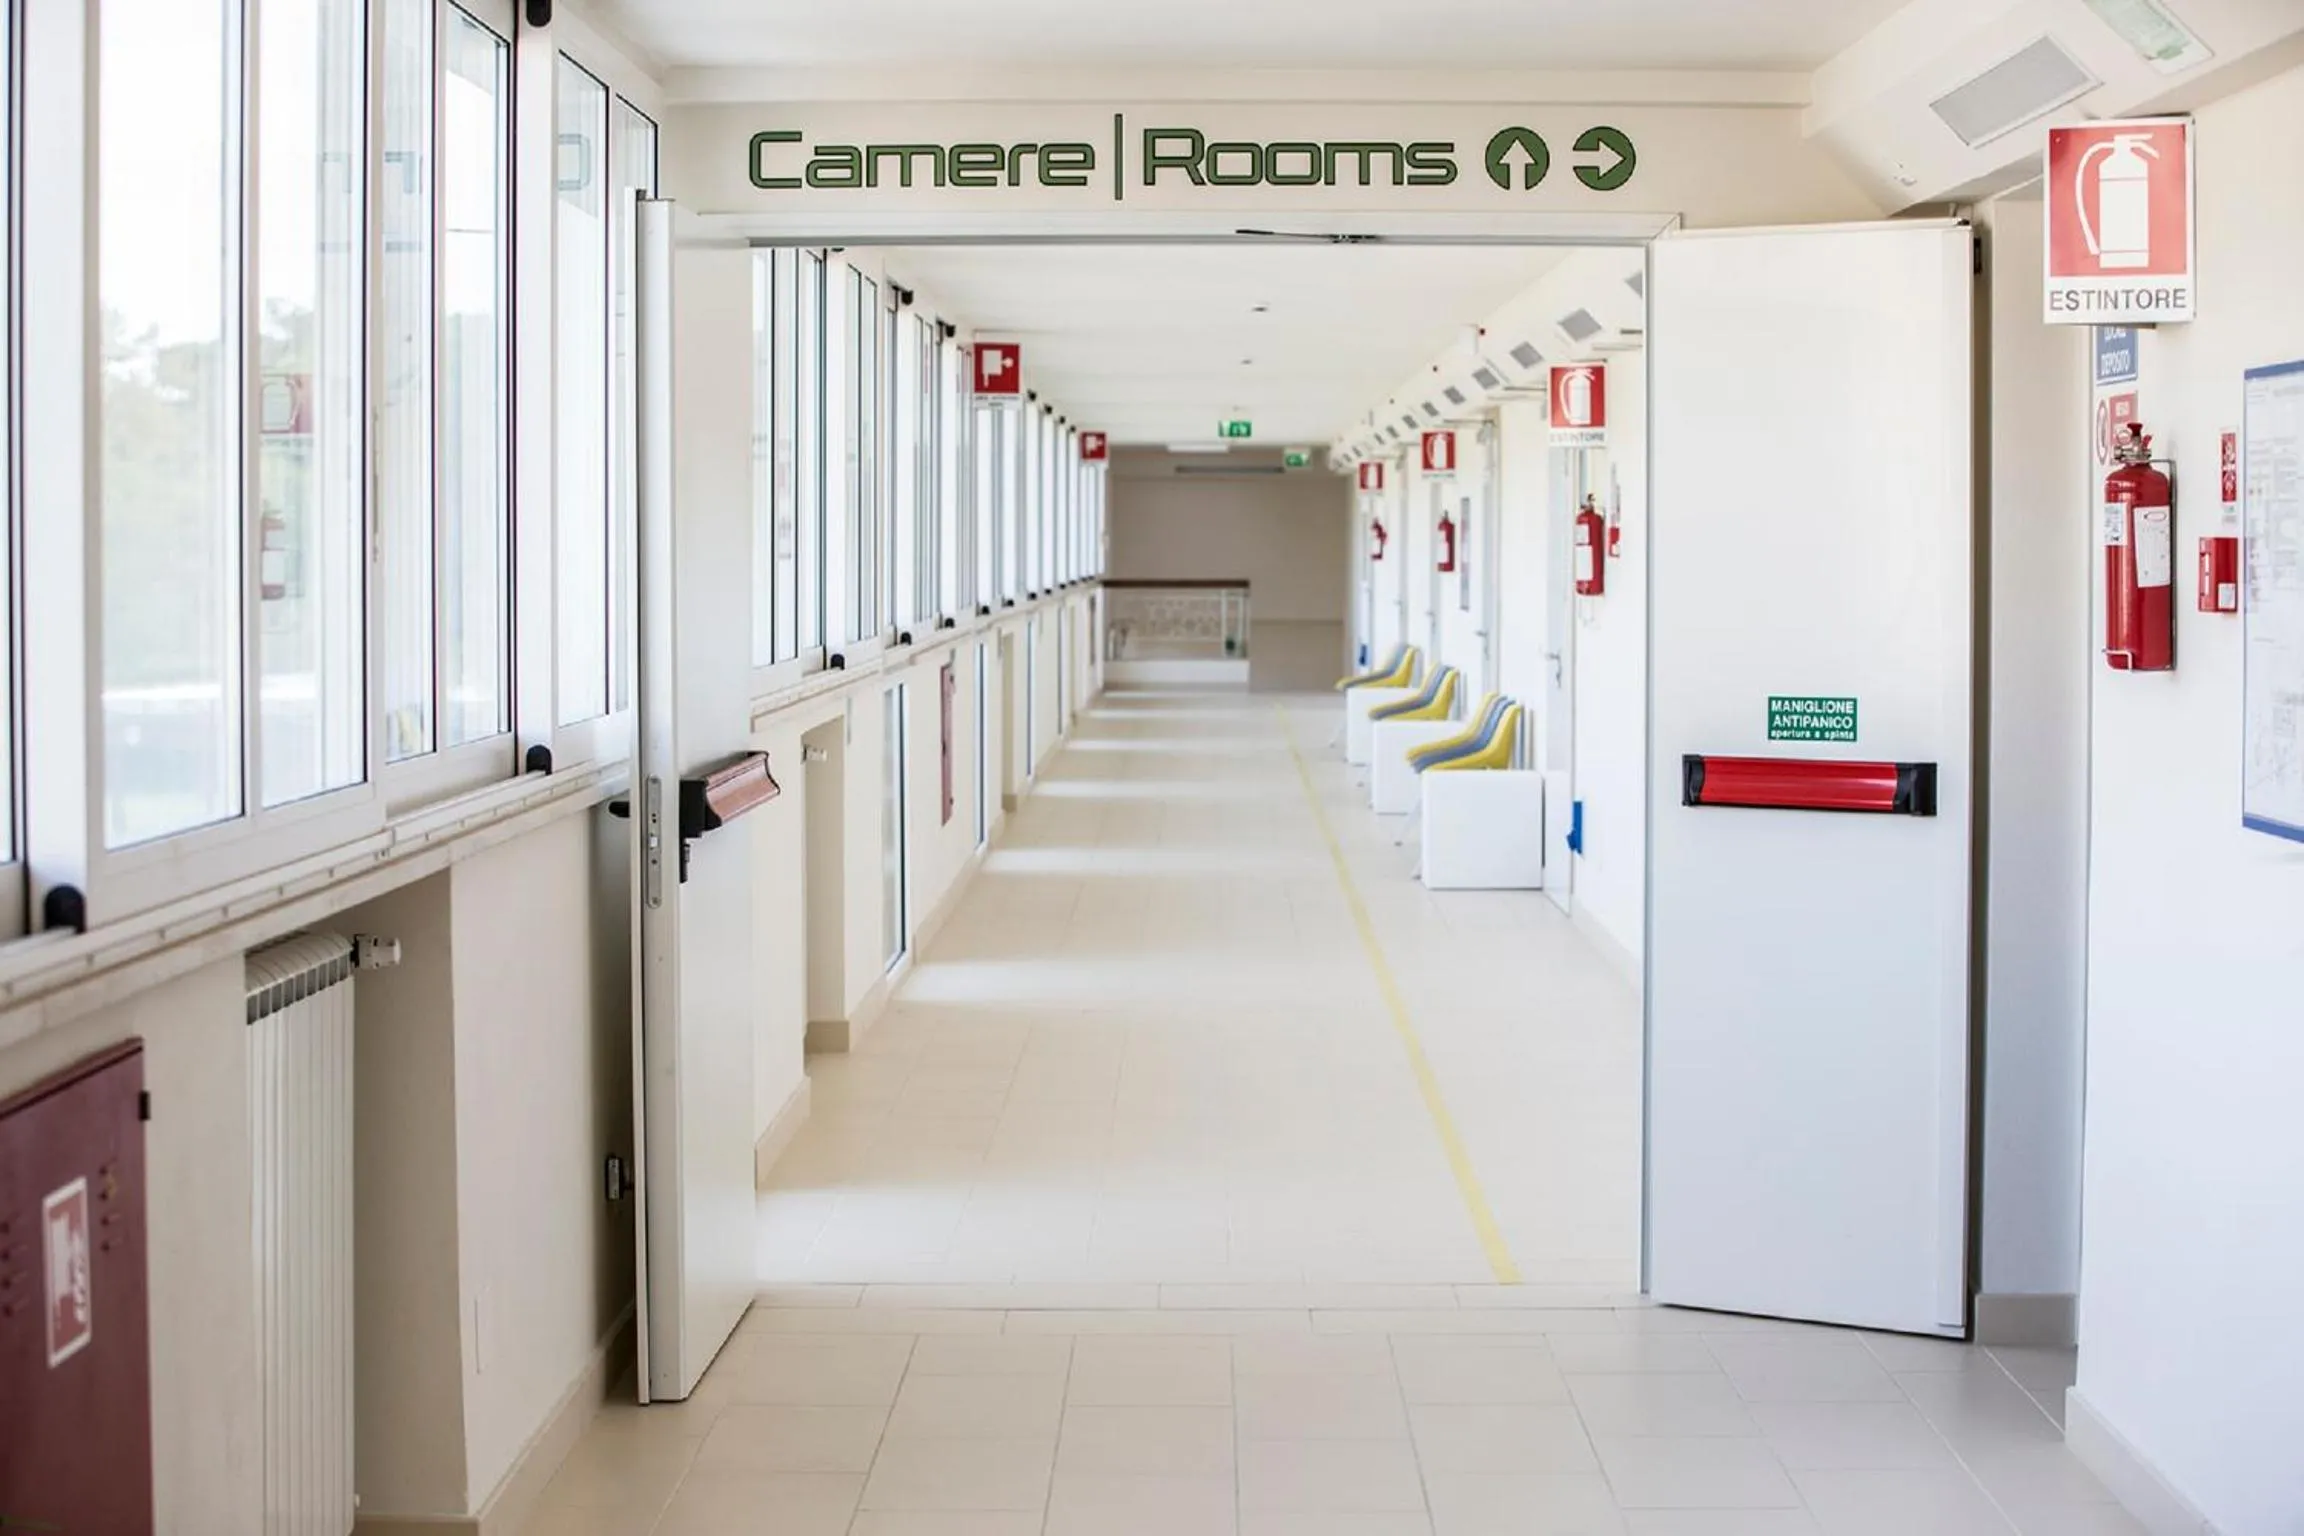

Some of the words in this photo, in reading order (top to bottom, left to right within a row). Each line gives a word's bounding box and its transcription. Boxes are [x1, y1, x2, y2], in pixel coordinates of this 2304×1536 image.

[749, 131, 1095, 189] Camere
[1143, 128, 1458, 186] Rooms
[2050, 288, 2186, 311] ESTINTORE
[2101, 350, 2130, 376] DEPOSITO
[1771, 700, 1854, 714] MANIGLIONE
[1772, 714, 1853, 729] ANTIPANICO
[1771, 730, 1811, 740] apertura
[1824, 731, 1854, 740] spinta
